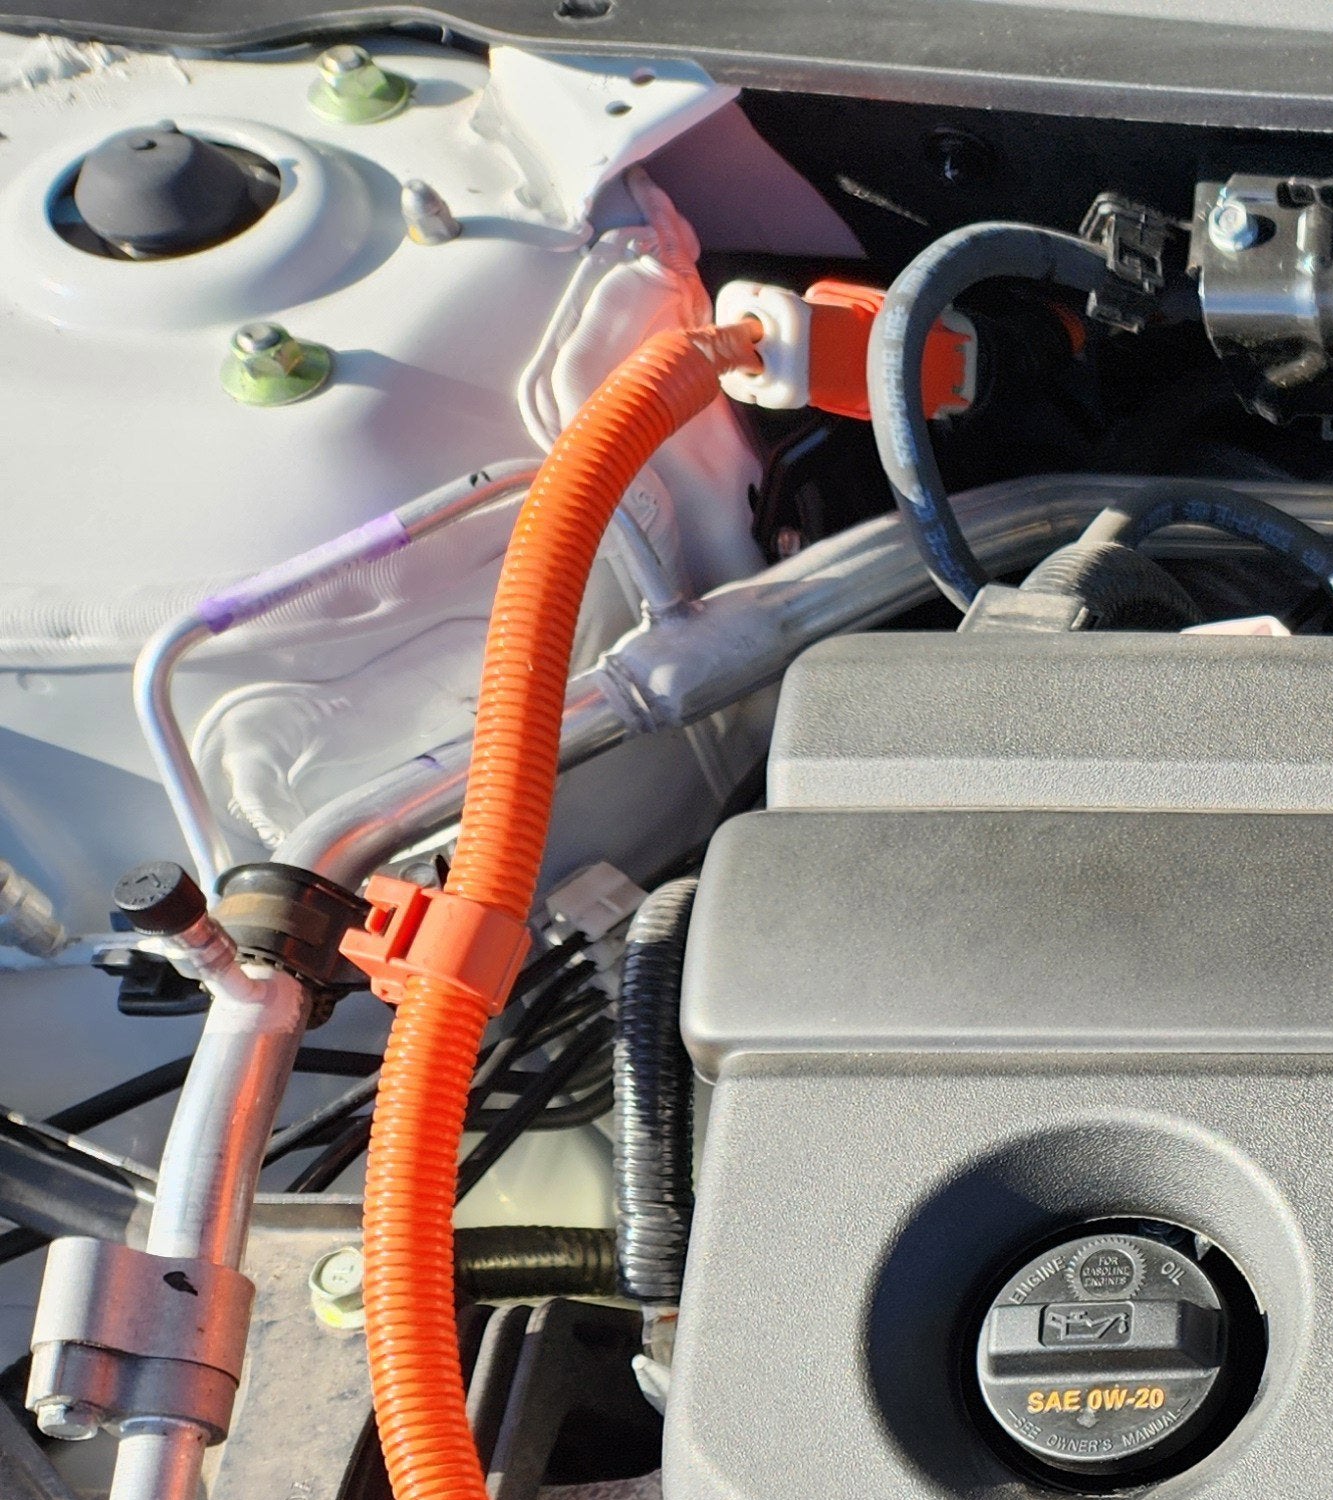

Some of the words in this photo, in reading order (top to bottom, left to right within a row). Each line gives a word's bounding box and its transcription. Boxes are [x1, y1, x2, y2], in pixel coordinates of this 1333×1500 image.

[1098, 1256, 1119, 1267] FOR
[1082, 1265, 1130, 1277] GASOLINE
[1009, 1256, 1066, 1304] ENGINE
[1160, 1261, 1186, 1286] OIL
[1083, 1276, 1127, 1287] ENGINES
[1027, 1389, 1081, 1414] SAE
[1087, 1385, 1165, 1411] 0W-20
[1046, 1434, 1113, 1453] OWNER'S
